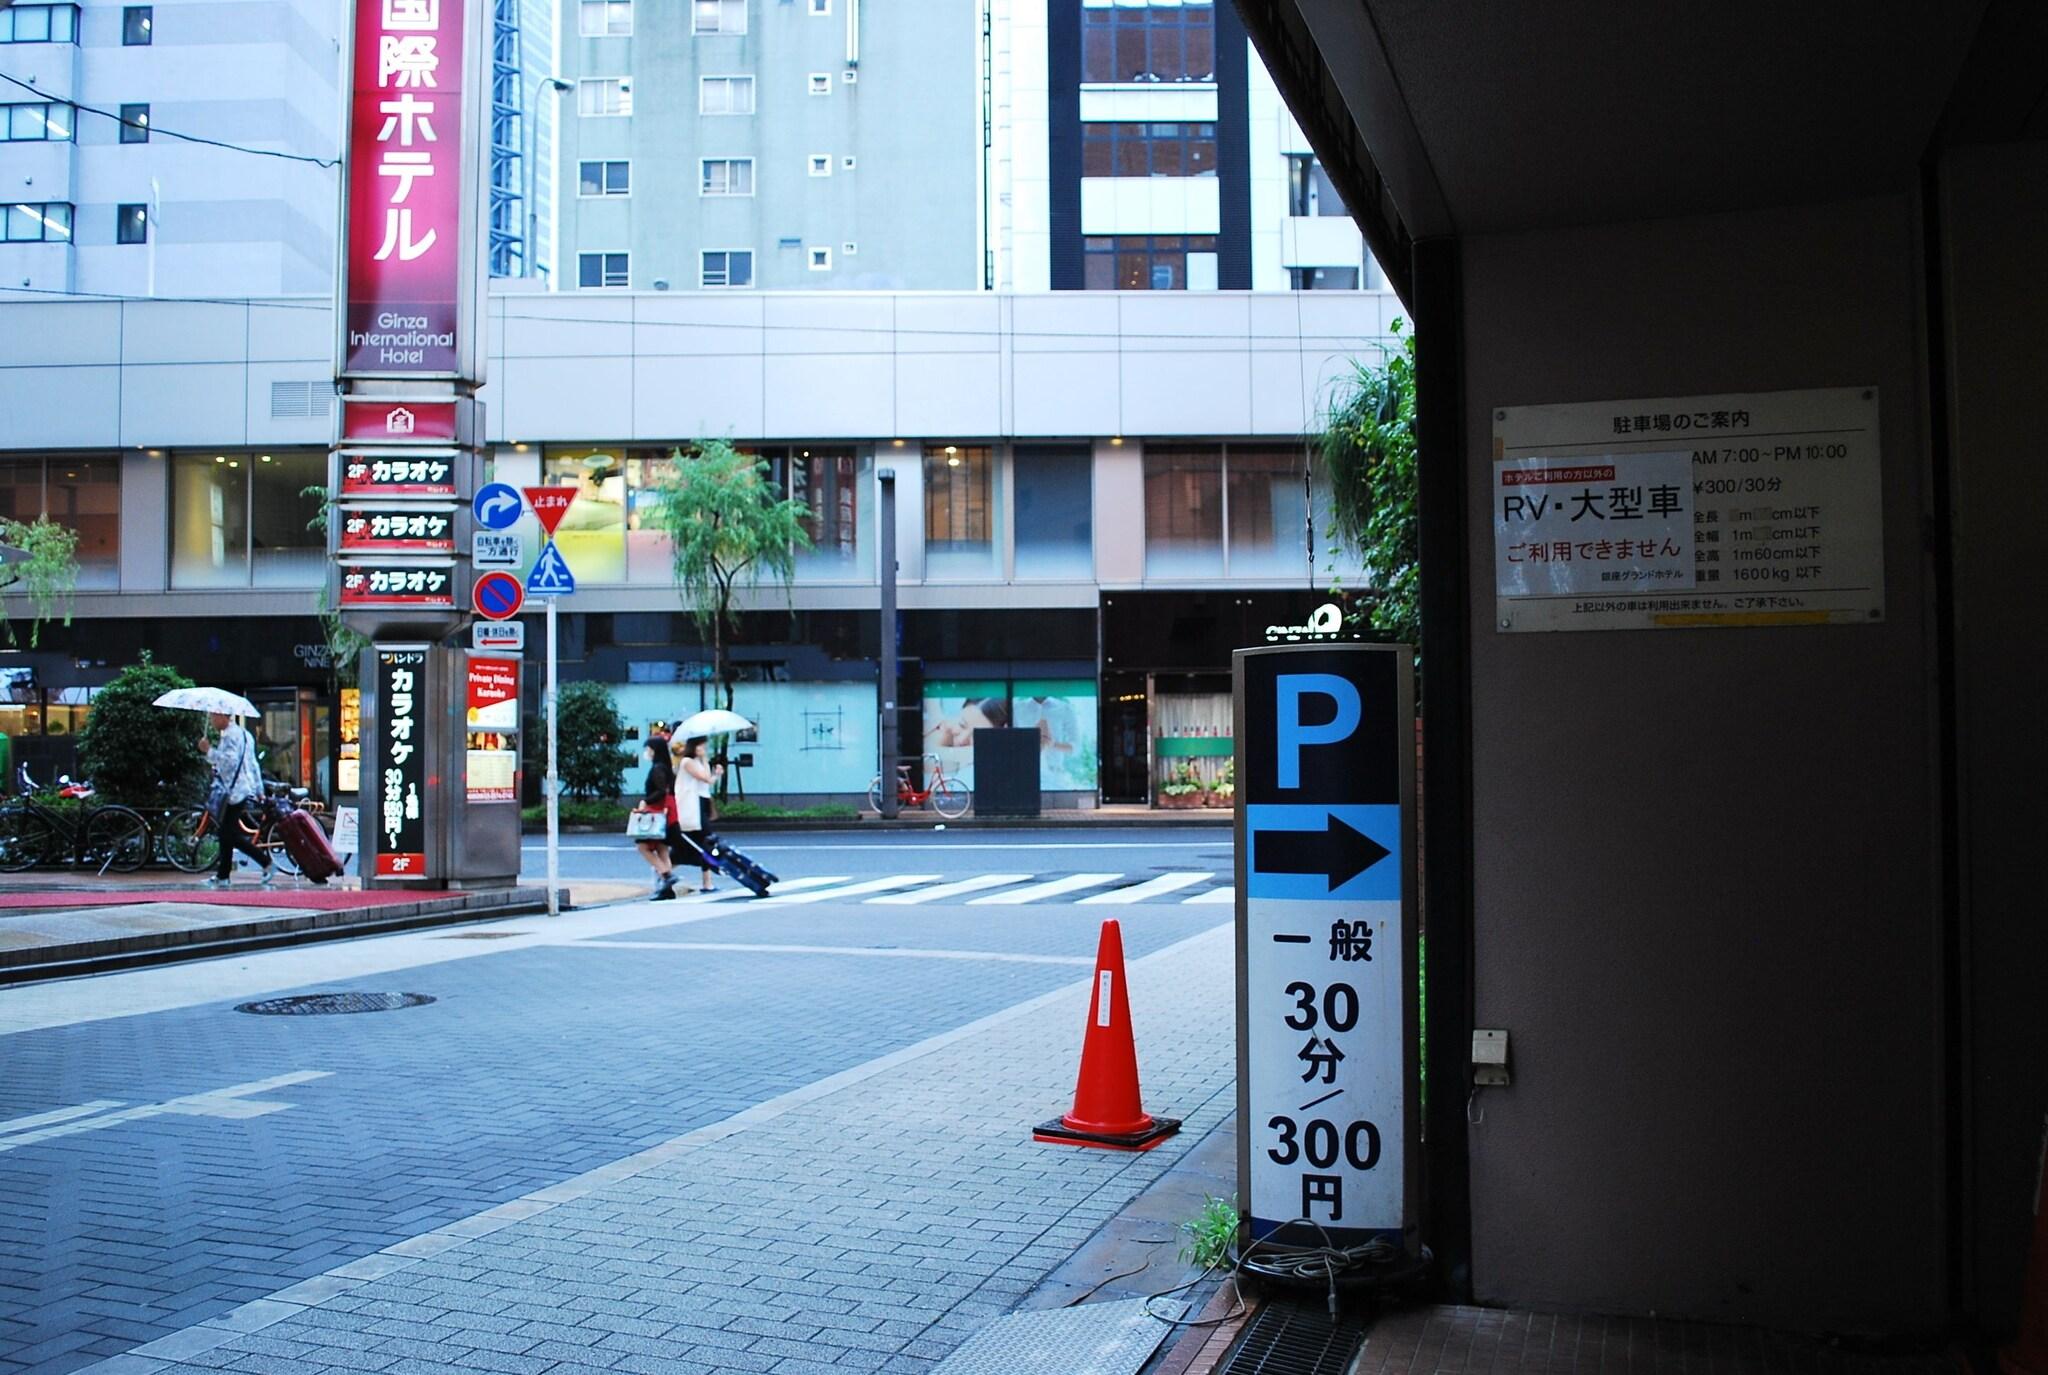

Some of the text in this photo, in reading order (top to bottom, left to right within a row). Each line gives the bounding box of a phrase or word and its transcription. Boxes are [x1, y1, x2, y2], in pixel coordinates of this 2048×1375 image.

[378, 313, 428, 328] Ginza
[350, 331, 454, 347] International
[380, 348, 424, 364] Hotel
[1613, 409, 1750, 433] 駐車場のご案内
[1691, 450, 1717, 464] AM
[1806, 445, 1848, 459] 10:00
[348, 460, 448, 482] 2F カラオケ
[534, 496, 567, 508] 止まれ
[1503, 484, 1682, 522] RV・大型車
[347, 515, 447, 537] 2F カラオケ
[477, 547, 519, 557] 一方通行
[1507, 537, 1682, 563] ご利用できません
[1733, 546, 1822, 560] 1m60cm以下
[345, 570, 446, 592] 2F カラオケ
[1600, 570, 1684, 582] 銀座グランドホテル
[294, 645, 334, 657] GINZA
[304, 657, 330, 668] NINE
[469, 672, 493, 683] Private
[477, 687, 506, 698] Karaoke
[391, 668, 414, 765] カラオケ
[1277, 673, 1362, 789] P
[393, 857, 410, 871] 2F
[1273, 919, 1373, 962] 一般
[1284, 981, 1360, 1033] 30
[1297, 1037, 1346, 1084] 分
[1267, 1116, 1381, 1171] 300
[1302, 1173, 1343, 1221] 円
